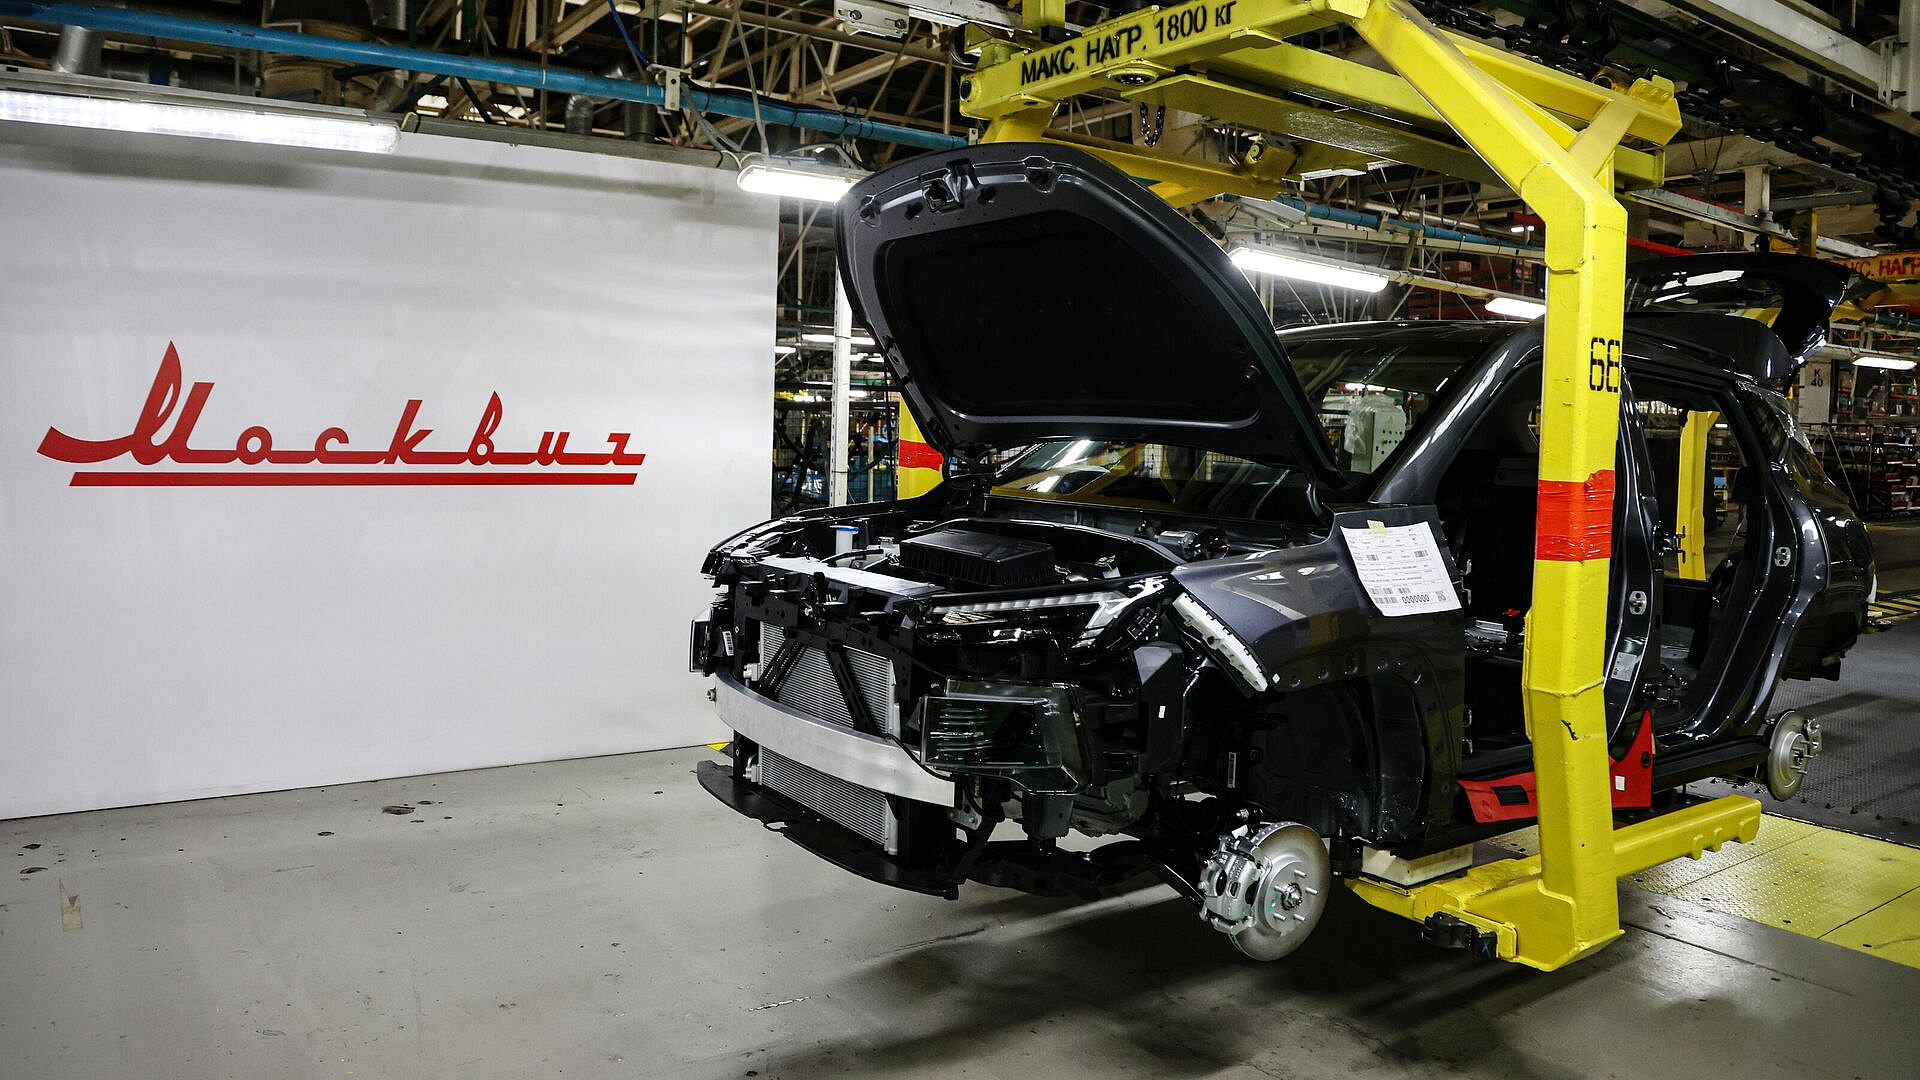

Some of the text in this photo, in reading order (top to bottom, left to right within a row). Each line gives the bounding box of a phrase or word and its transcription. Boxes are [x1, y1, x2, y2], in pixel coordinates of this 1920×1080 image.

[1021, 45, 1079, 86] МАКС.
[1086, 23, 1147, 66] НАГР.
[1155, 5, 1208, 45] 1800
[1589, 336, 1620, 393] 68
[1810, 378, 1824, 388] 40
